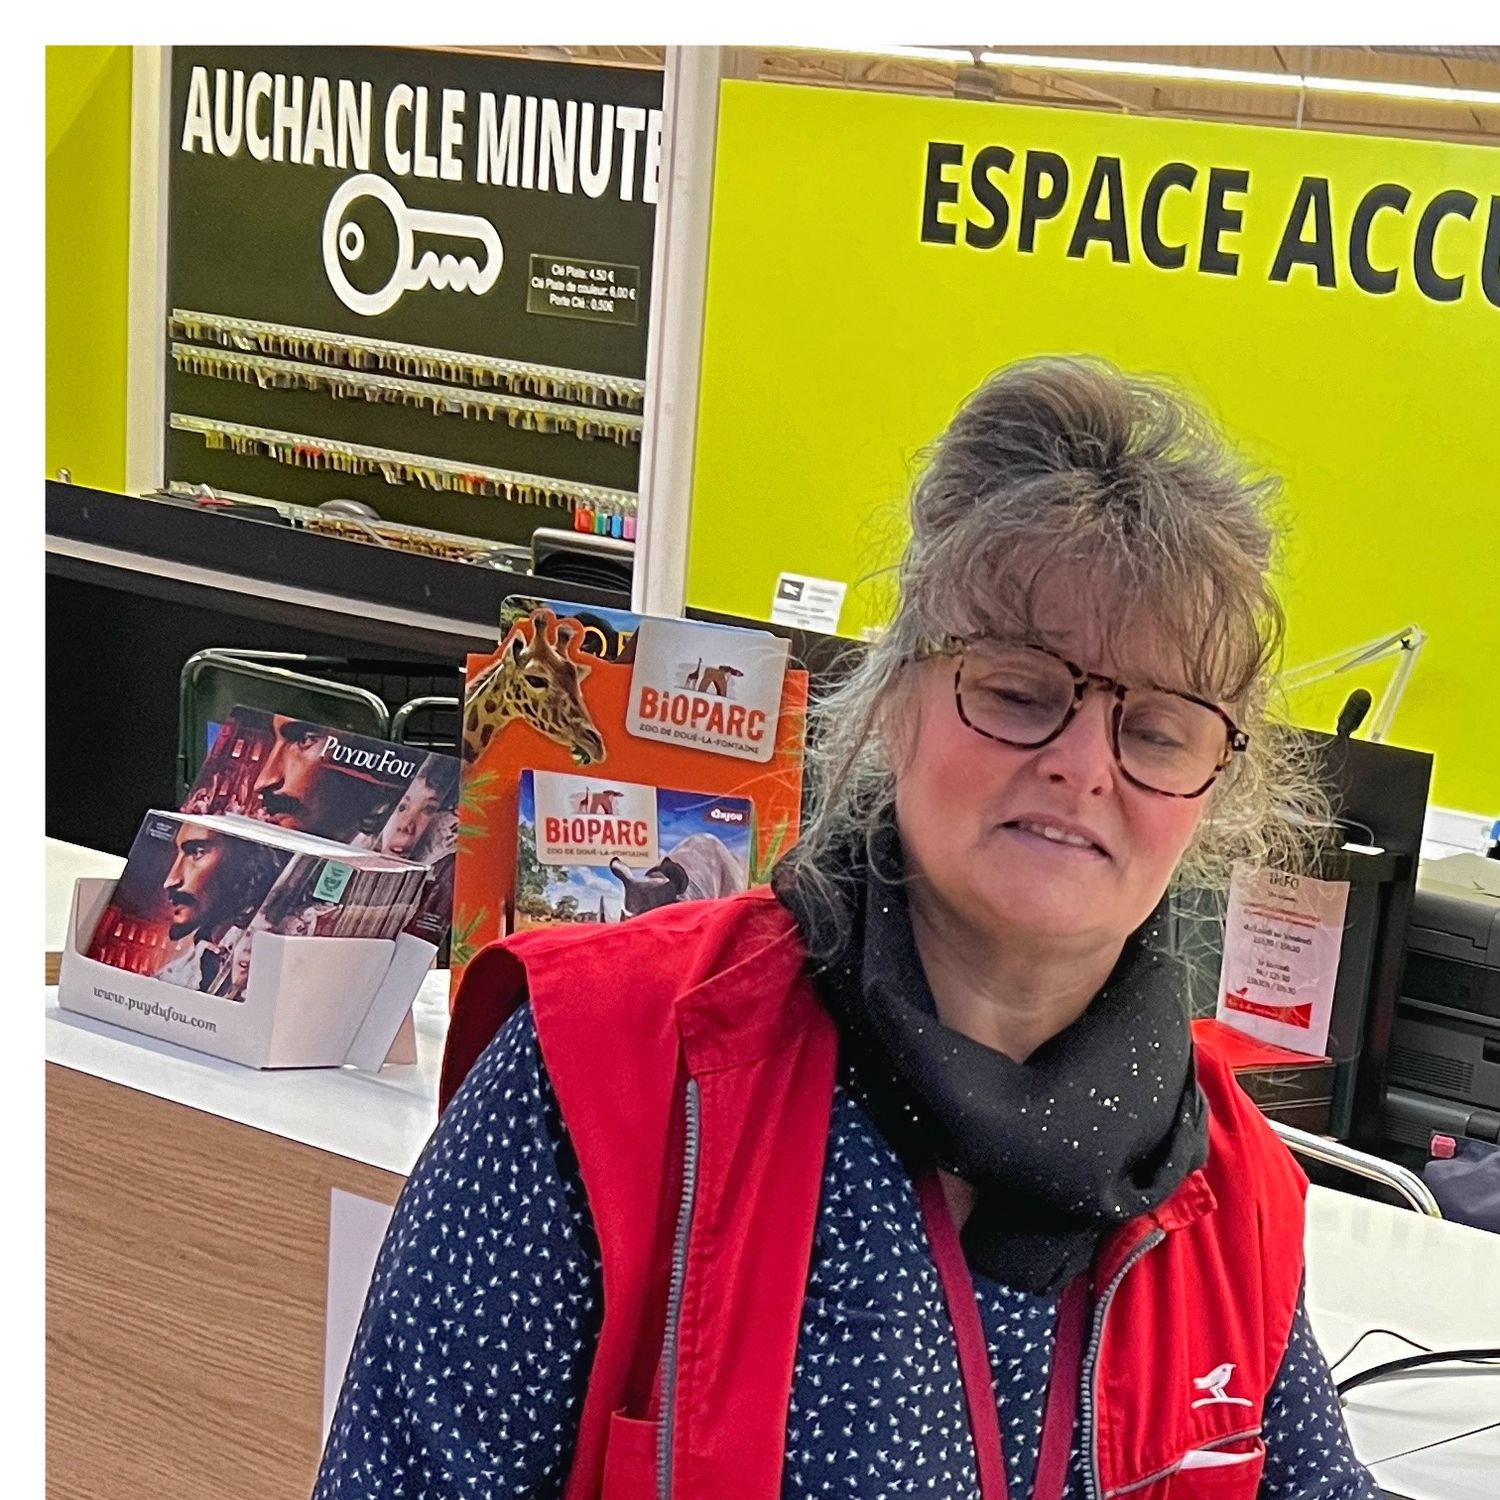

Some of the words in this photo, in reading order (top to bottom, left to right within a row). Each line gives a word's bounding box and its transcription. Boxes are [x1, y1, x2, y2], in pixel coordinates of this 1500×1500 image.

[181, 66, 372, 170] AUCHAN
[384, 83, 466, 182] CLE
[918, 141, 1253, 278] ESPACE
[639, 723, 659, 734] ZOO
[660, 727, 672, 737] DE
[93, 986, 217, 1033] www.puydufou.com
